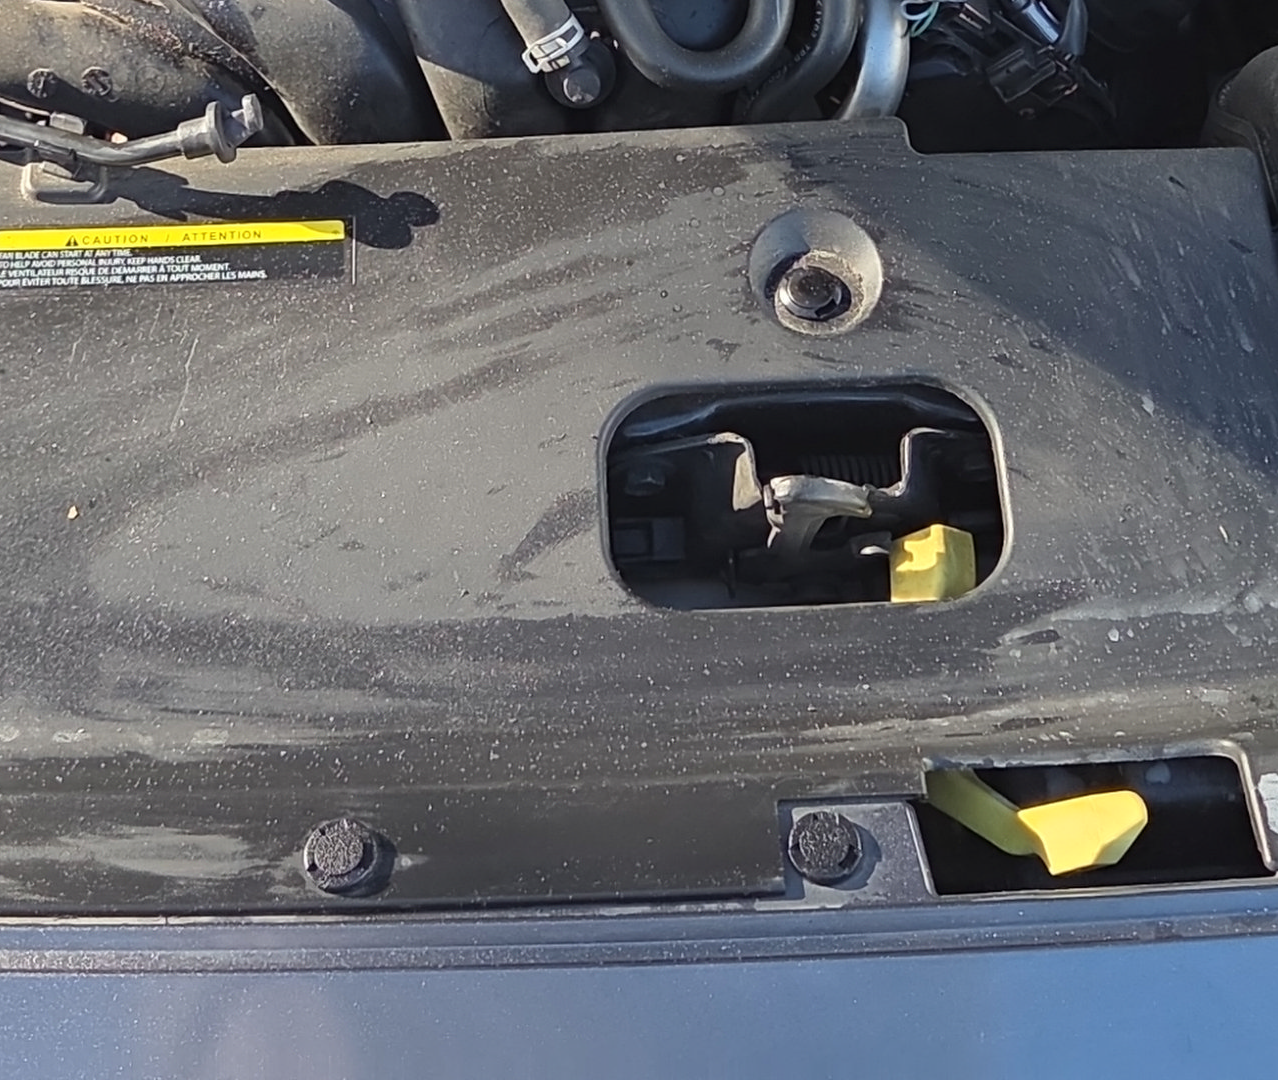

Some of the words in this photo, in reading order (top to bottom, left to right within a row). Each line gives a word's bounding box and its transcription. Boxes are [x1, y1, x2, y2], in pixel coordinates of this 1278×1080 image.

[82, 234, 149, 246] CAUTION
[181, 230, 262, 242] ATTENTION
[10, 260, 31, 269] HELP
[31, 259, 57, 268] AVOID
[57, 258, 97, 267] PERSONAL
[127, 257, 147, 266] KEEP
[147, 256, 176, 265] HANDS
[15, 251, 40, 260] BLADE
[41, 250, 59, 259] CAN
[59, 250, 83, 258] START
[83, 250, 94, 258] AT
[8, 268, 64, 278] VENTILATEUR
[65, 267, 97, 277] RISQUE
[98, 267, 110, 276] DE
[166, 263, 190, 273] TOUT
[190, 262, 231, 272] MOMENT.
[52, 277, 80, 286] TOUTE
[125, 275, 138, 284] NE
[138, 274, 155, 283] PAS
[156, 273, 167, 282] EN
[169, 272, 220, 282] APPROCHER
[221, 271, 236, 280] LES
